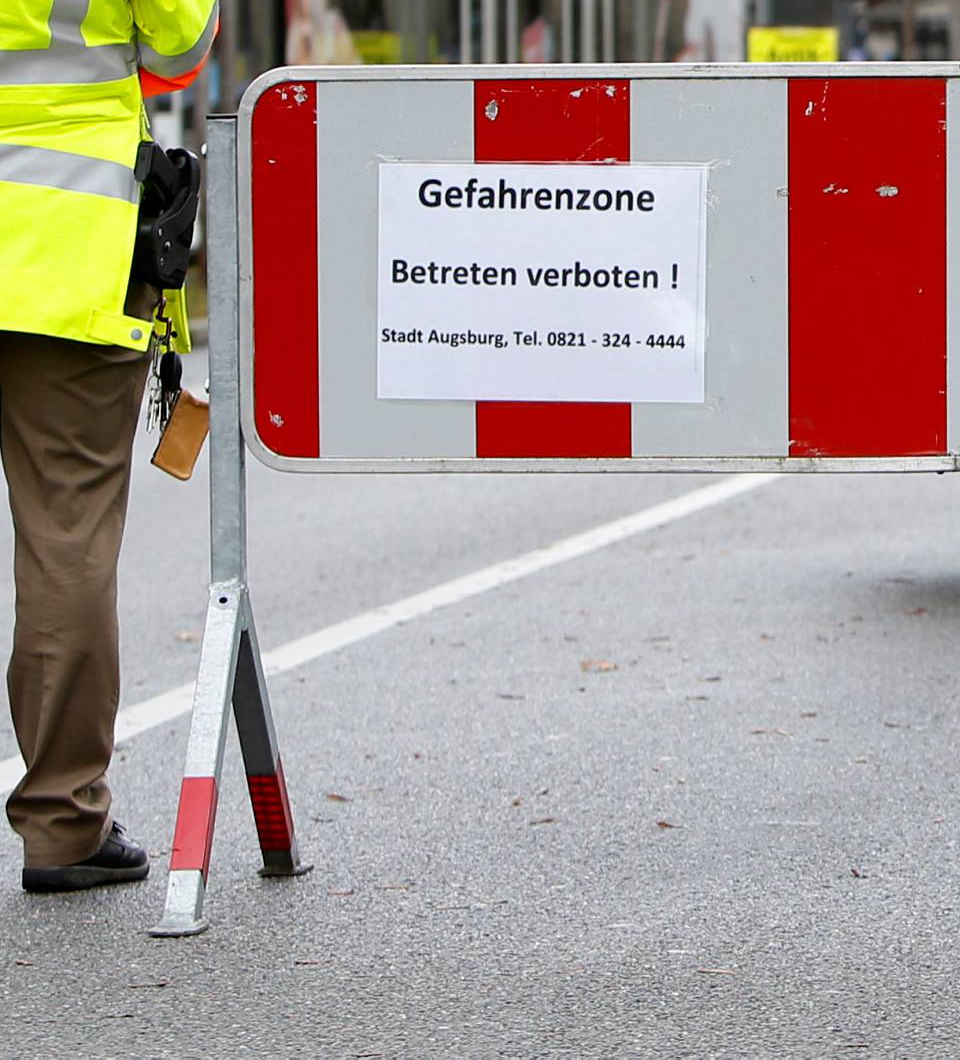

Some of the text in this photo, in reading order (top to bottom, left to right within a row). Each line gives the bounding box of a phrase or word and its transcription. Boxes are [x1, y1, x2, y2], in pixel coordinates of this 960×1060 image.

[418, 177, 655, 213] Gefahrenzone
[391, 258, 680, 290] Betreten verboten !
[381, 327, 424, 344] Stadt
[427, 329, 509, 349] Augsburg,
[512, 330, 543, 347] Tel.
[546, 331, 587, 347] 0821
[601, 332, 632, 348] 324
[645, 333, 686, 349] 4444
